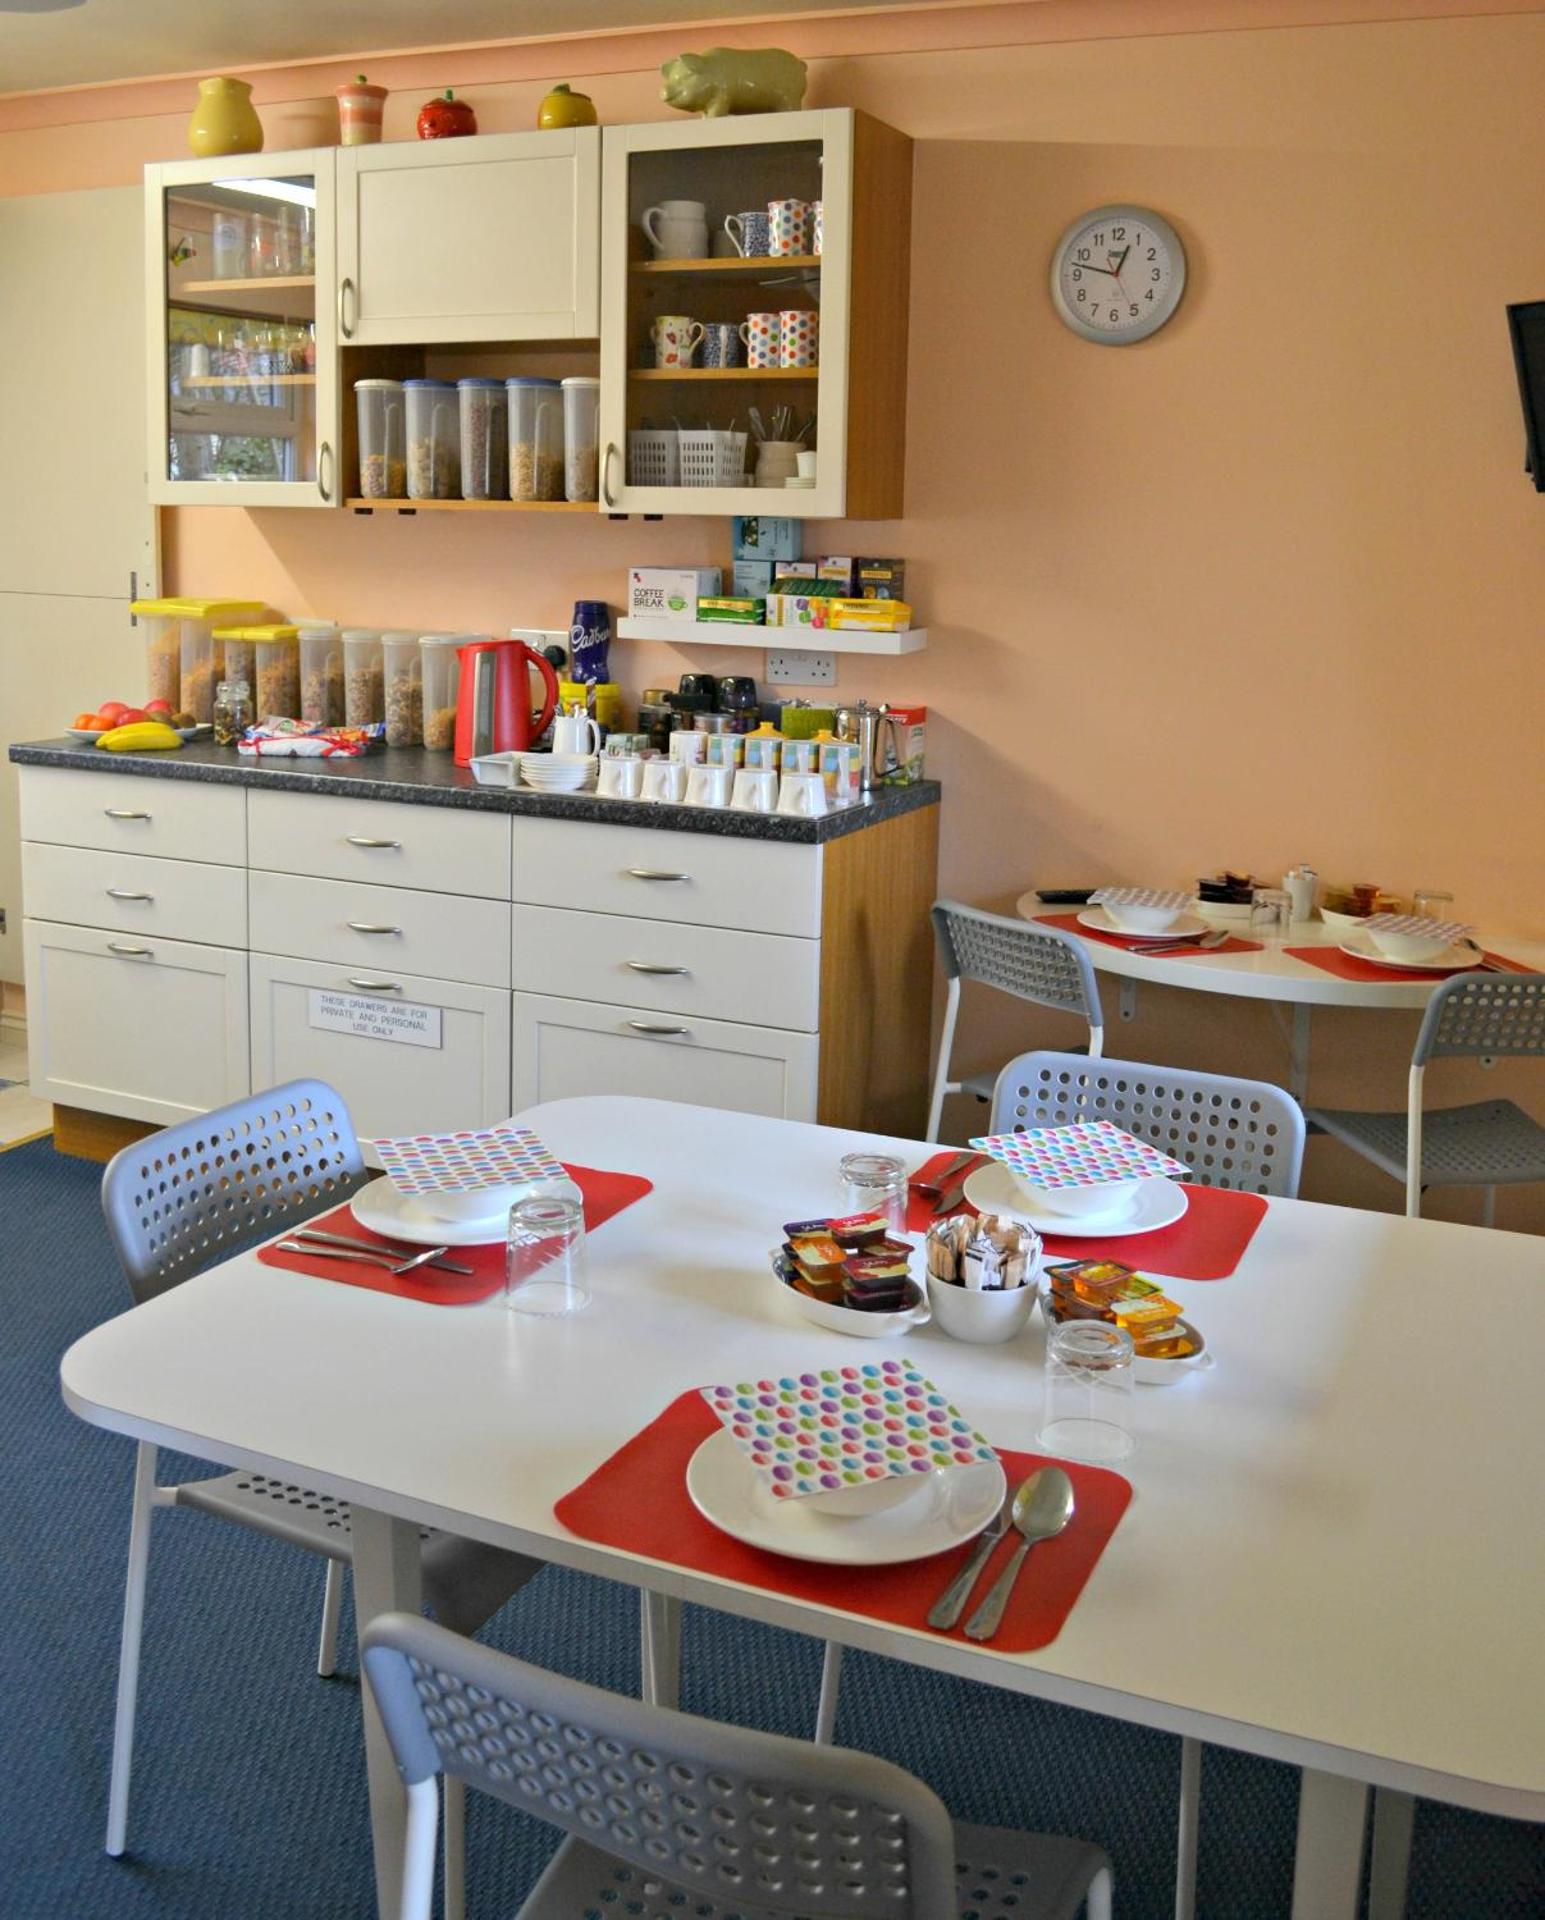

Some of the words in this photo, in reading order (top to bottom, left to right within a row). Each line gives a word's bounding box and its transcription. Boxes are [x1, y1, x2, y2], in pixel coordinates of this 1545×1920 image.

[1093, 233, 1104, 246] 11
[1112, 227, 1126, 241] 12
[1077, 249, 1091, 261] 10
[1147, 248, 1156, 261] 2
[1072, 269, 1082, 281] 9
[1151, 268, 1160, 281] 3
[1077, 289, 1086, 301] 8
[1144, 289, 1153, 301] 4
[1091, 304, 1099, 316] 7
[1109, 309, 1119, 322] 6
[1129, 304, 1139, 316] 5
[634, 588, 664, 599] COFFEE
[634, 598, 665, 608] BREAK
[349, 999, 388, 1014] DRAWERS
[391, 1005, 408, 1017] ARE
[410, 1008, 427, 1020] FOR
[320, 1005, 354, 1020] PRIVATE
[359, 1013, 377, 1023] AND
[381, 1015, 427, 1032] PERSONAL
[352, 1022, 367, 1032] USE
[372, 1025, 393, 1036] ONLY
